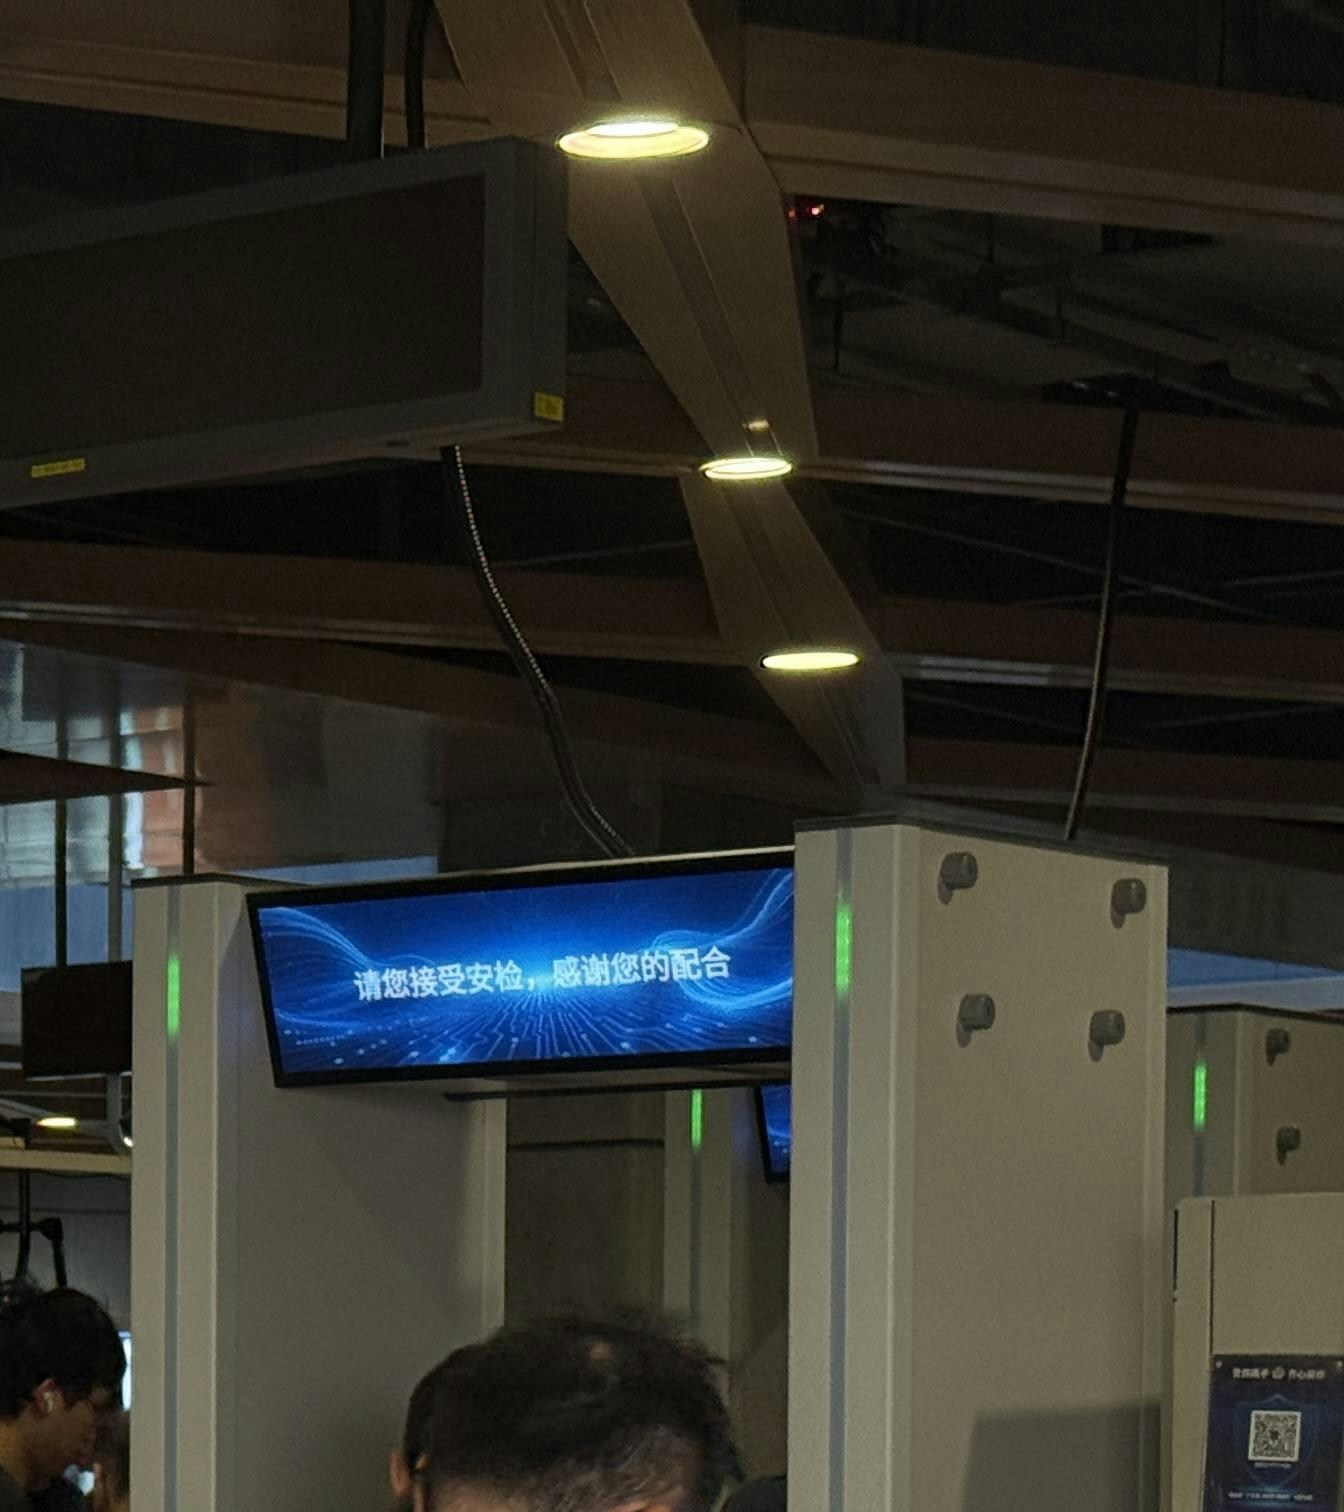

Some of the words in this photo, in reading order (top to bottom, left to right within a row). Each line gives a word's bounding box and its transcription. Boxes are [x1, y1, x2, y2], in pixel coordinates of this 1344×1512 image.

[354, 946, 731, 1001] 请您接受安检，感谢您的配合
